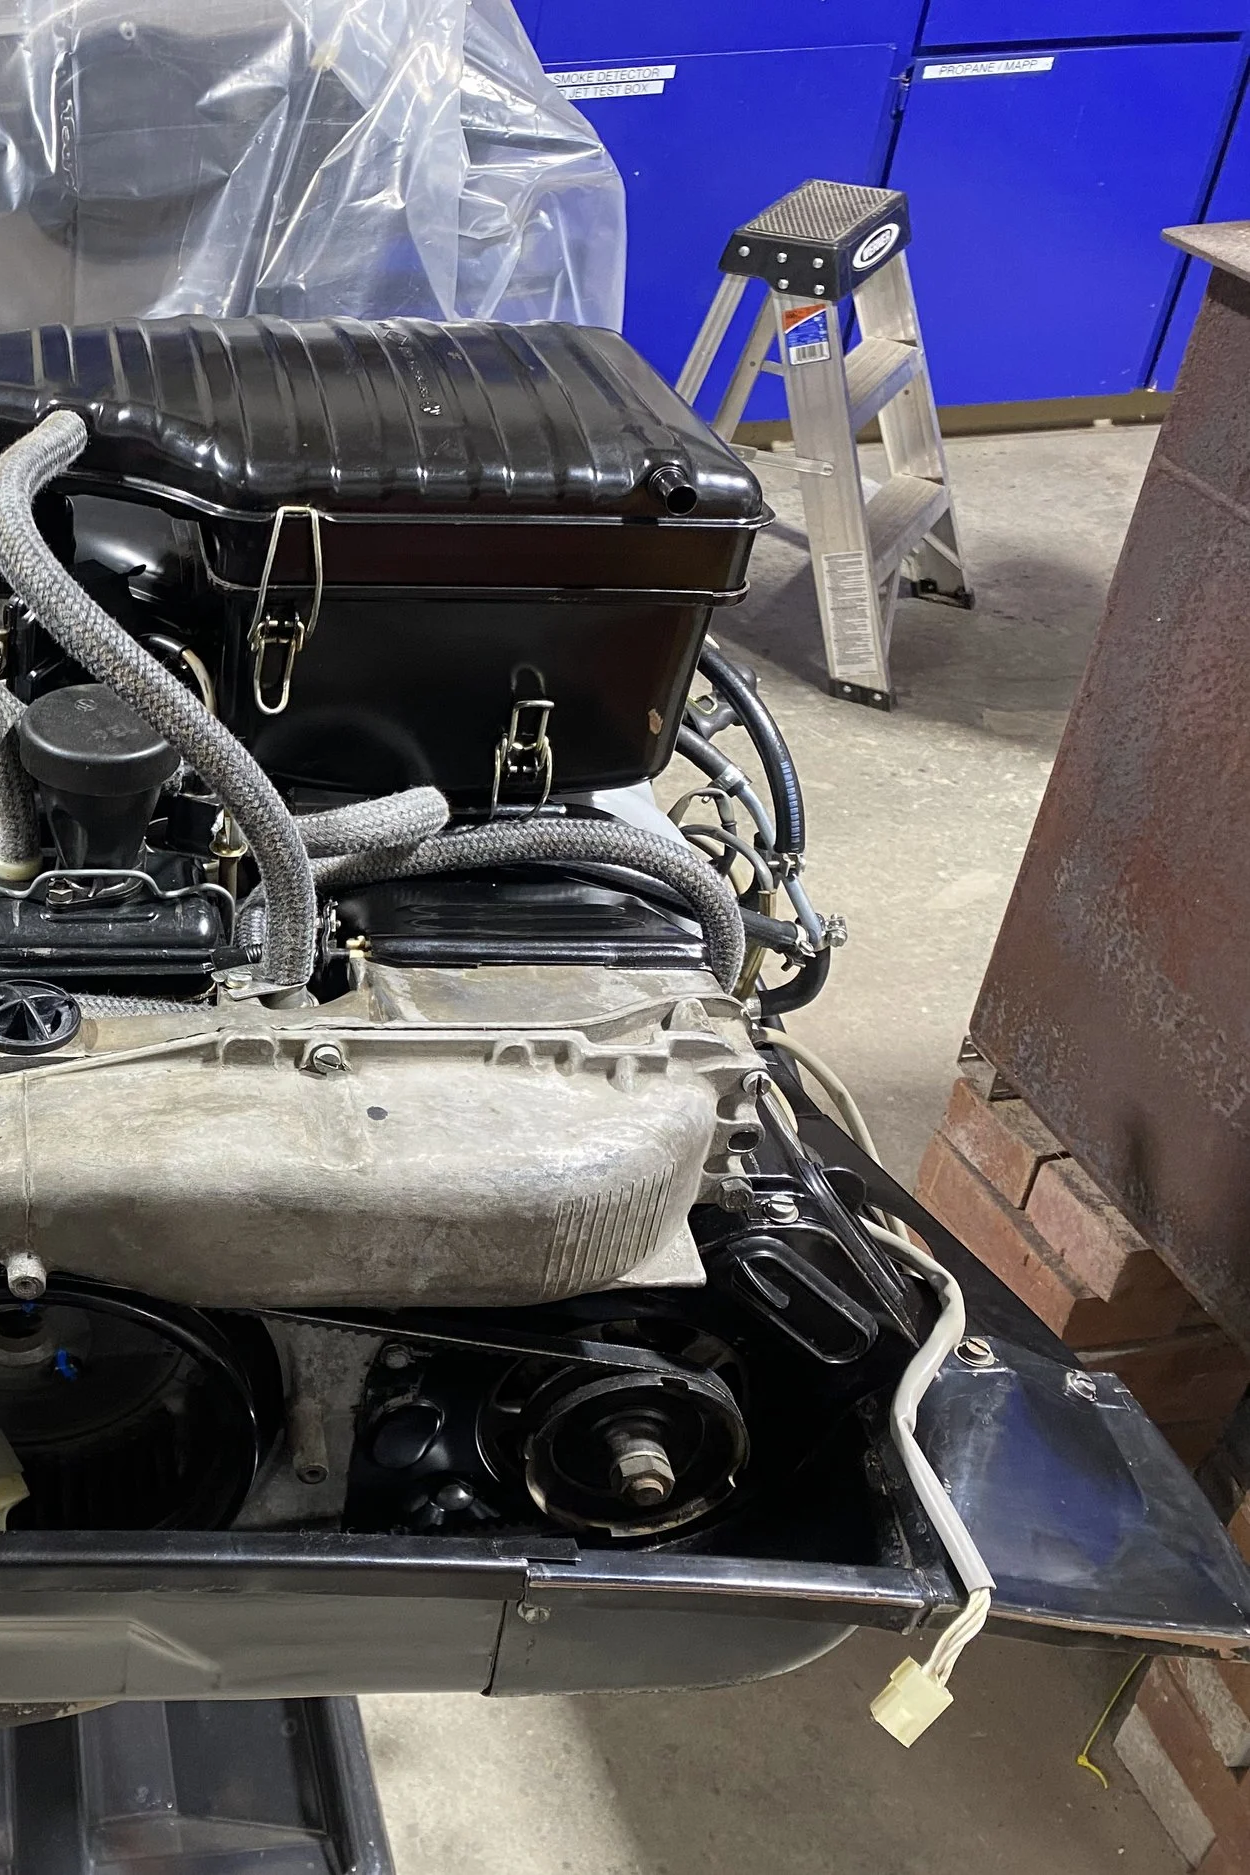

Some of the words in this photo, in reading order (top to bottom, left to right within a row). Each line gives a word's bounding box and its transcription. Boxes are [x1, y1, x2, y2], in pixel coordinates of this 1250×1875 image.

[940, 63, 994, 75] PROPANE
[1005, 60, 1037, 70] MAPP
[554, 73, 593, 84] SMOKE
[598, 68, 659, 81] DETECTOR
[569, 88, 589, 98] JET
[594, 86, 620, 96] TEST
[625, 84, 647, 94] BOX
